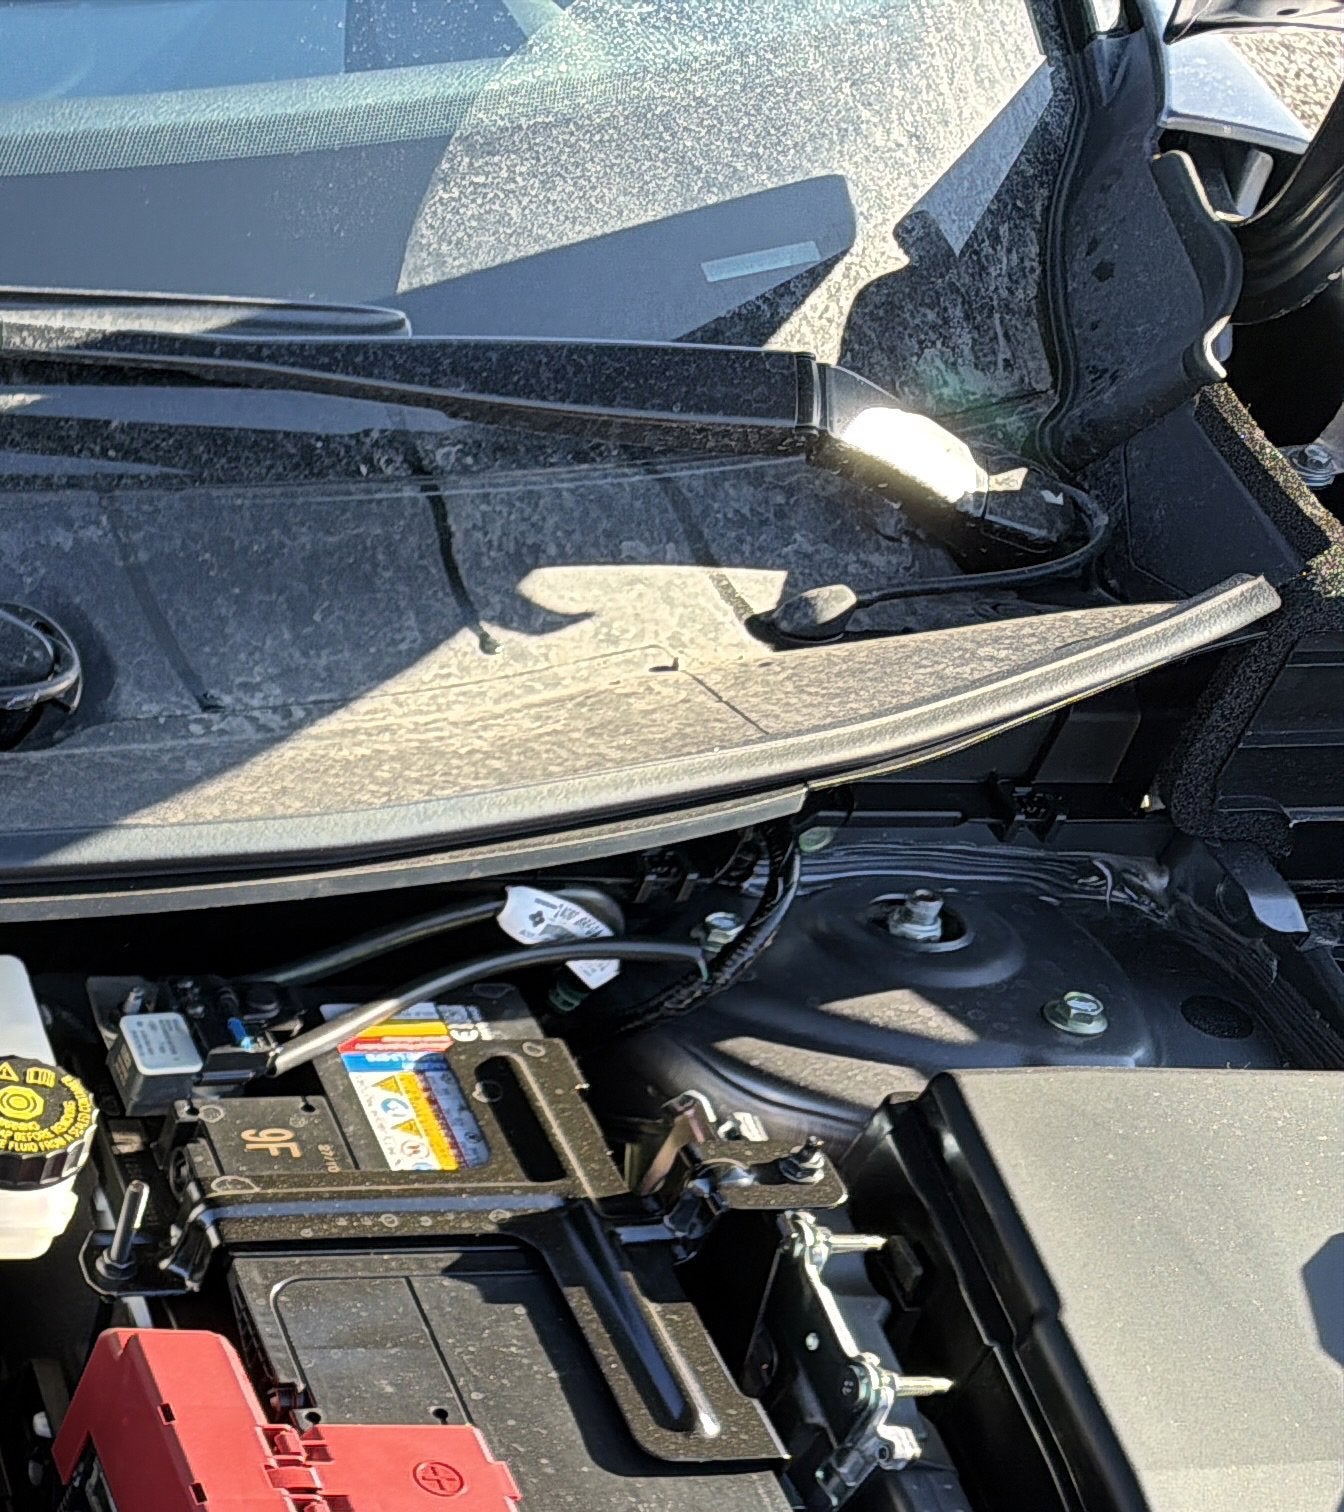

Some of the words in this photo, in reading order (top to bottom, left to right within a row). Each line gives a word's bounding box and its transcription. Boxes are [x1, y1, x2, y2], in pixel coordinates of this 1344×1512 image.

[14, 1128, 53, 1142] BEFORE
[9, 1141, 38, 1151] FLUID
[39, 1136, 67, 1150] FROM
[240, 1127, 304, 1159] 9F
